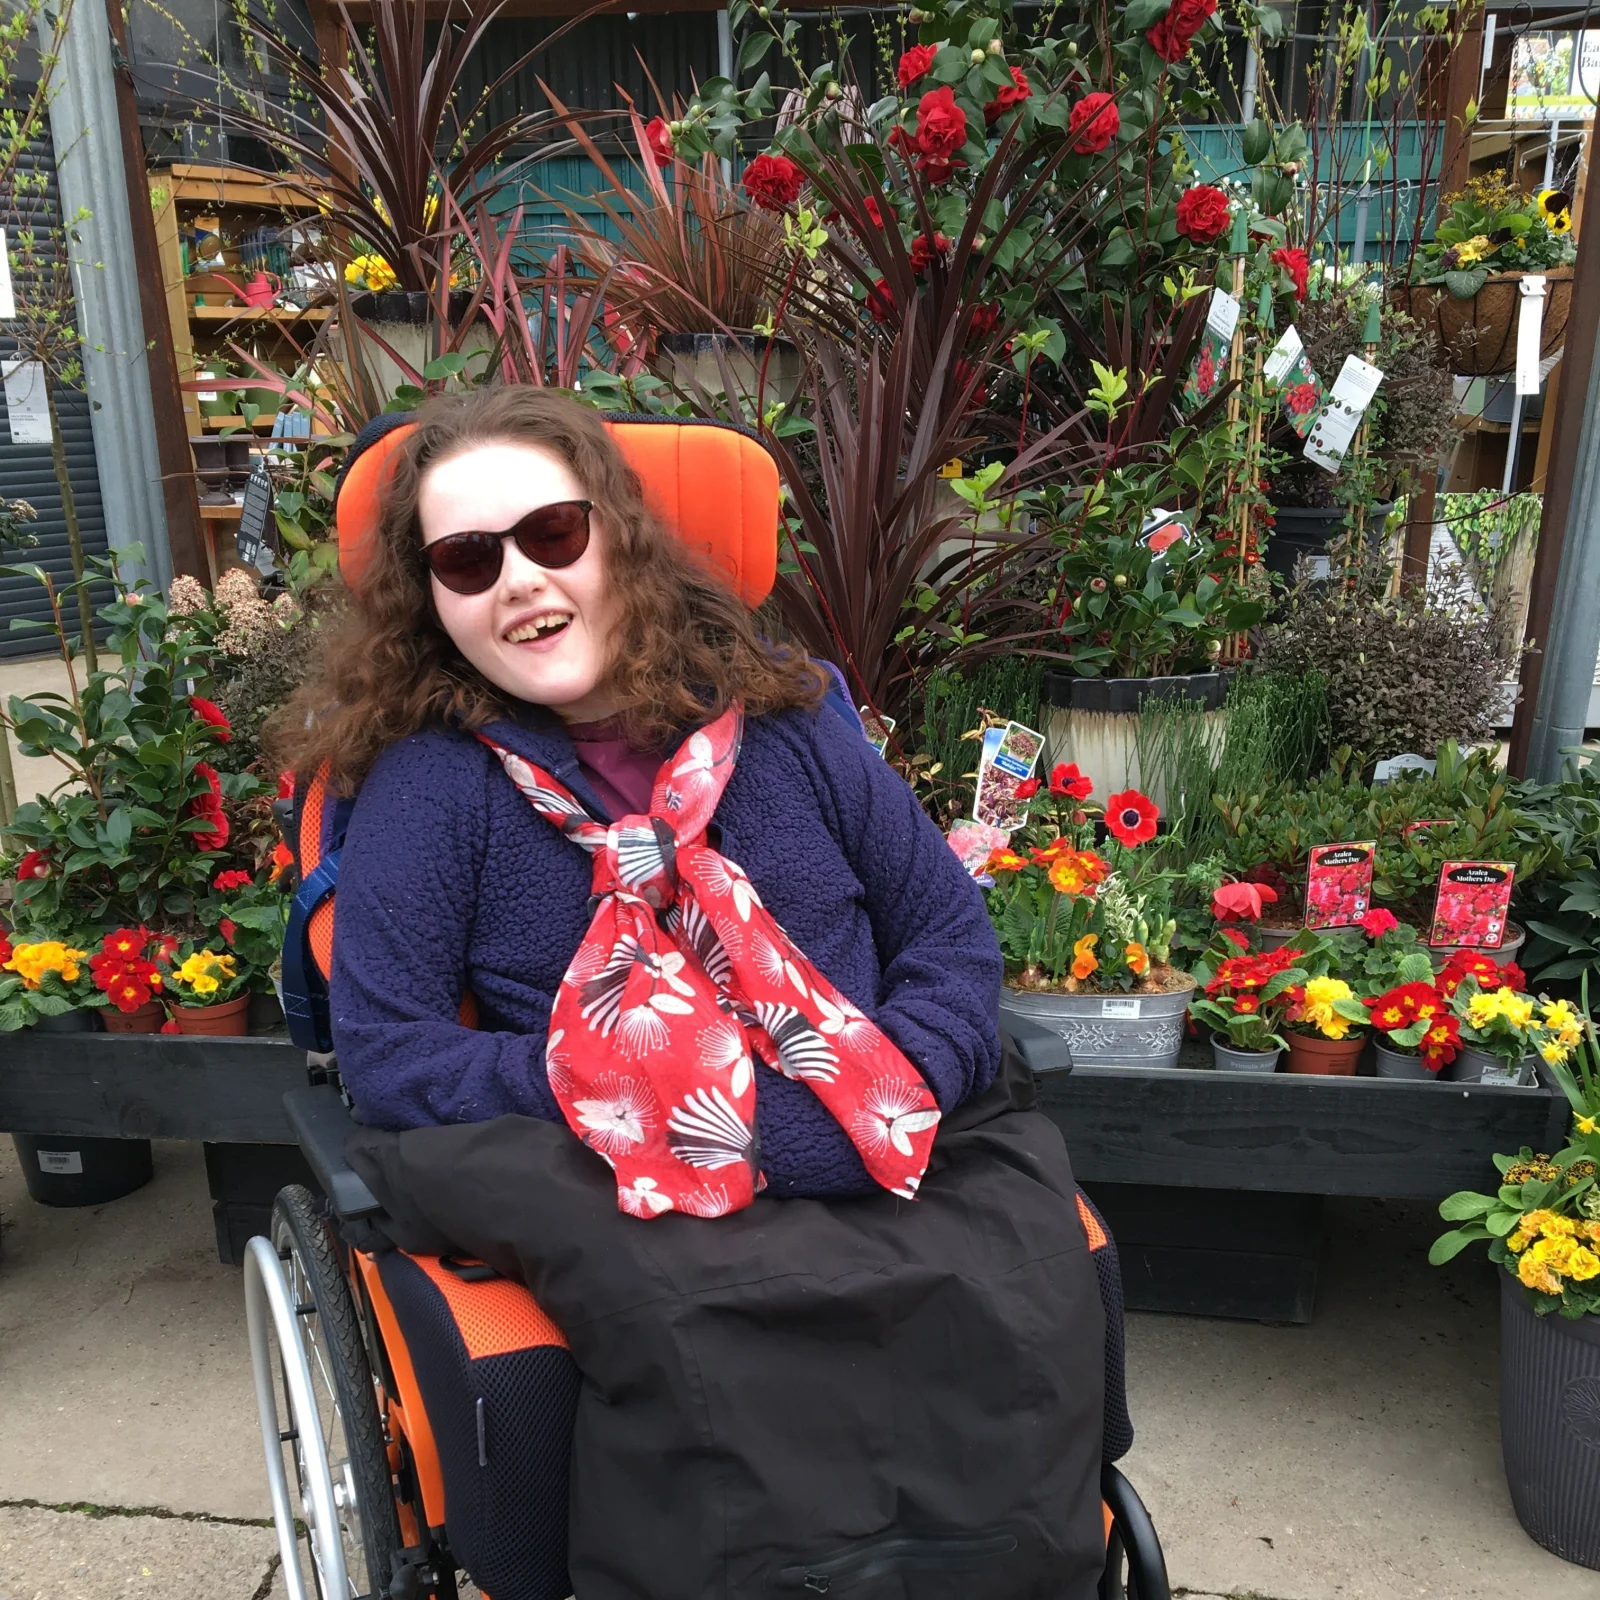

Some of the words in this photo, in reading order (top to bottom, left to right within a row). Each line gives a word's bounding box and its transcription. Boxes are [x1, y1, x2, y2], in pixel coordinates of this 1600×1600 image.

[1583, 41, 1599, 52] Ea
[1581, 56, 1600, 67] Ba
[1324, 857, 1348, 865] Mothers
